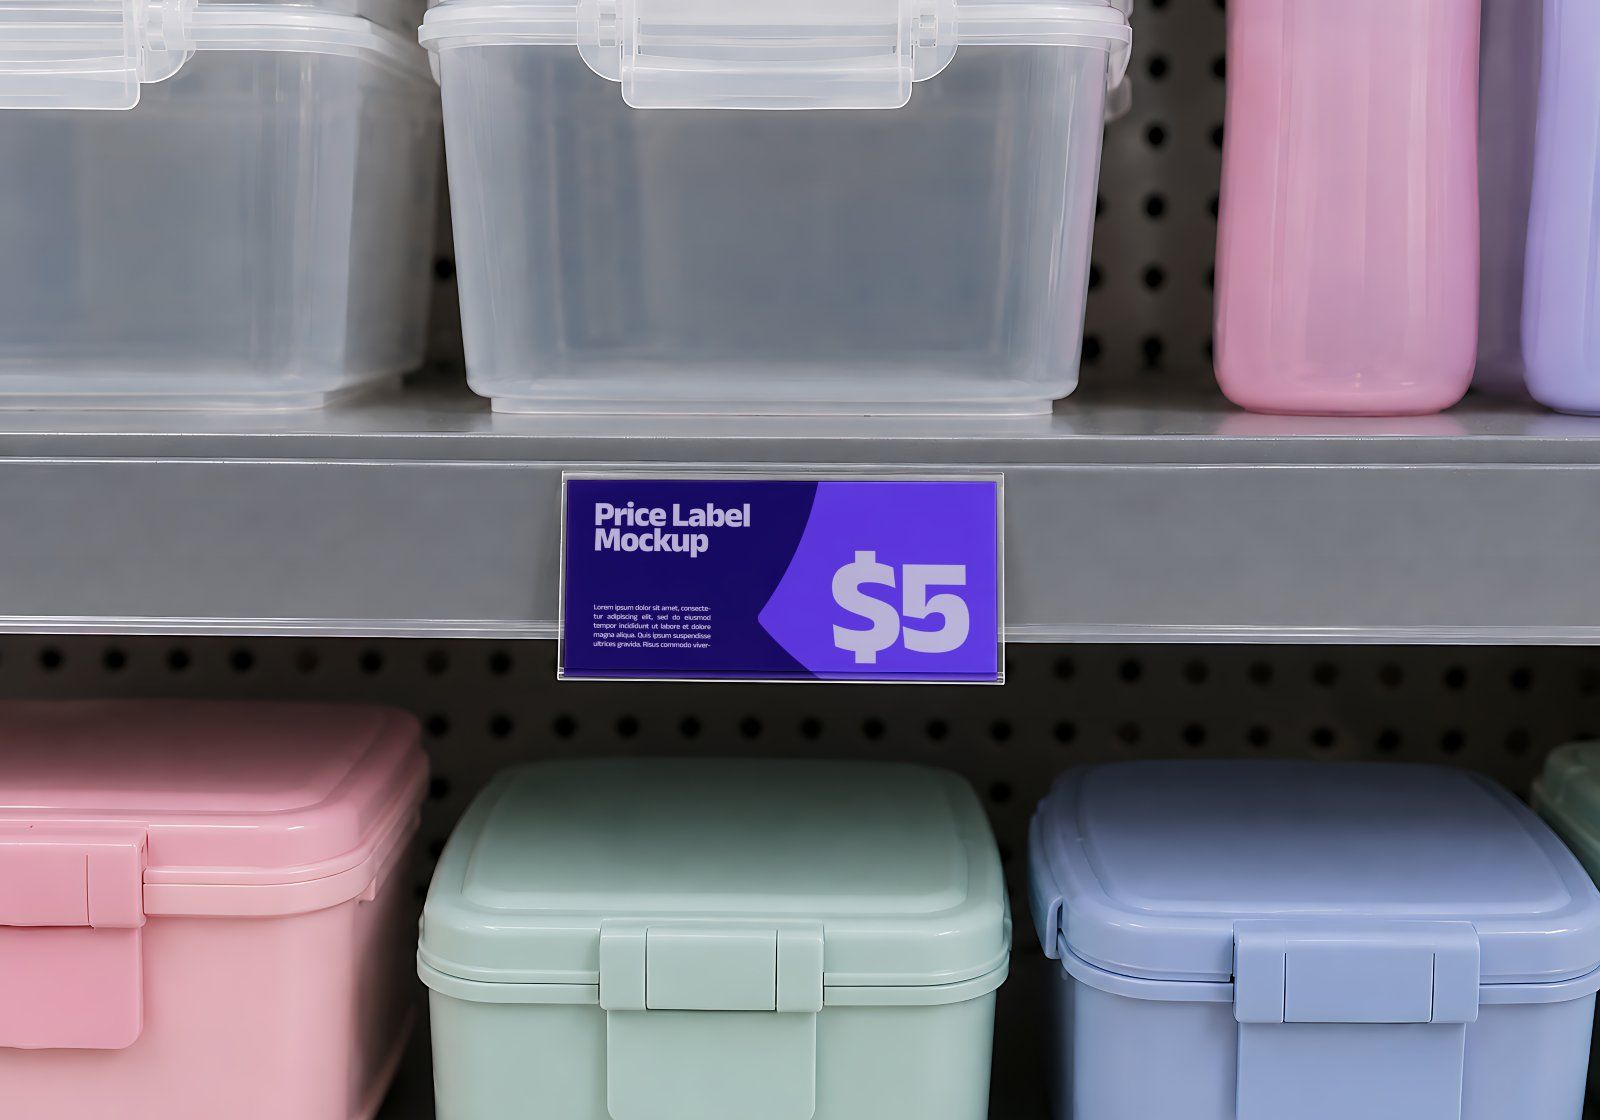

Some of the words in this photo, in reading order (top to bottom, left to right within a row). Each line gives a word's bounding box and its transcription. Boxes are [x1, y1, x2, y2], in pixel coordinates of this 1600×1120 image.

[594, 502, 667, 527] Price
[672, 503, 751, 528] Label
[594, 528, 709, 558] Mockup
[614, 604, 633, 612] ipsum
[831, 550, 970, 664] $5
[606, 613, 638, 621] adipiscing
[593, 622, 617, 630] tempor
[618, 622, 649, 630] incididunt
[615, 631, 636, 639] aliqua.
[637, 631, 651, 639] Quis
[652, 631, 671, 639] ipsum
[672, 632, 711, 640] suspendisse
[616, 640, 641, 648] gravida.
[692, 641, 711, 649] viver-
